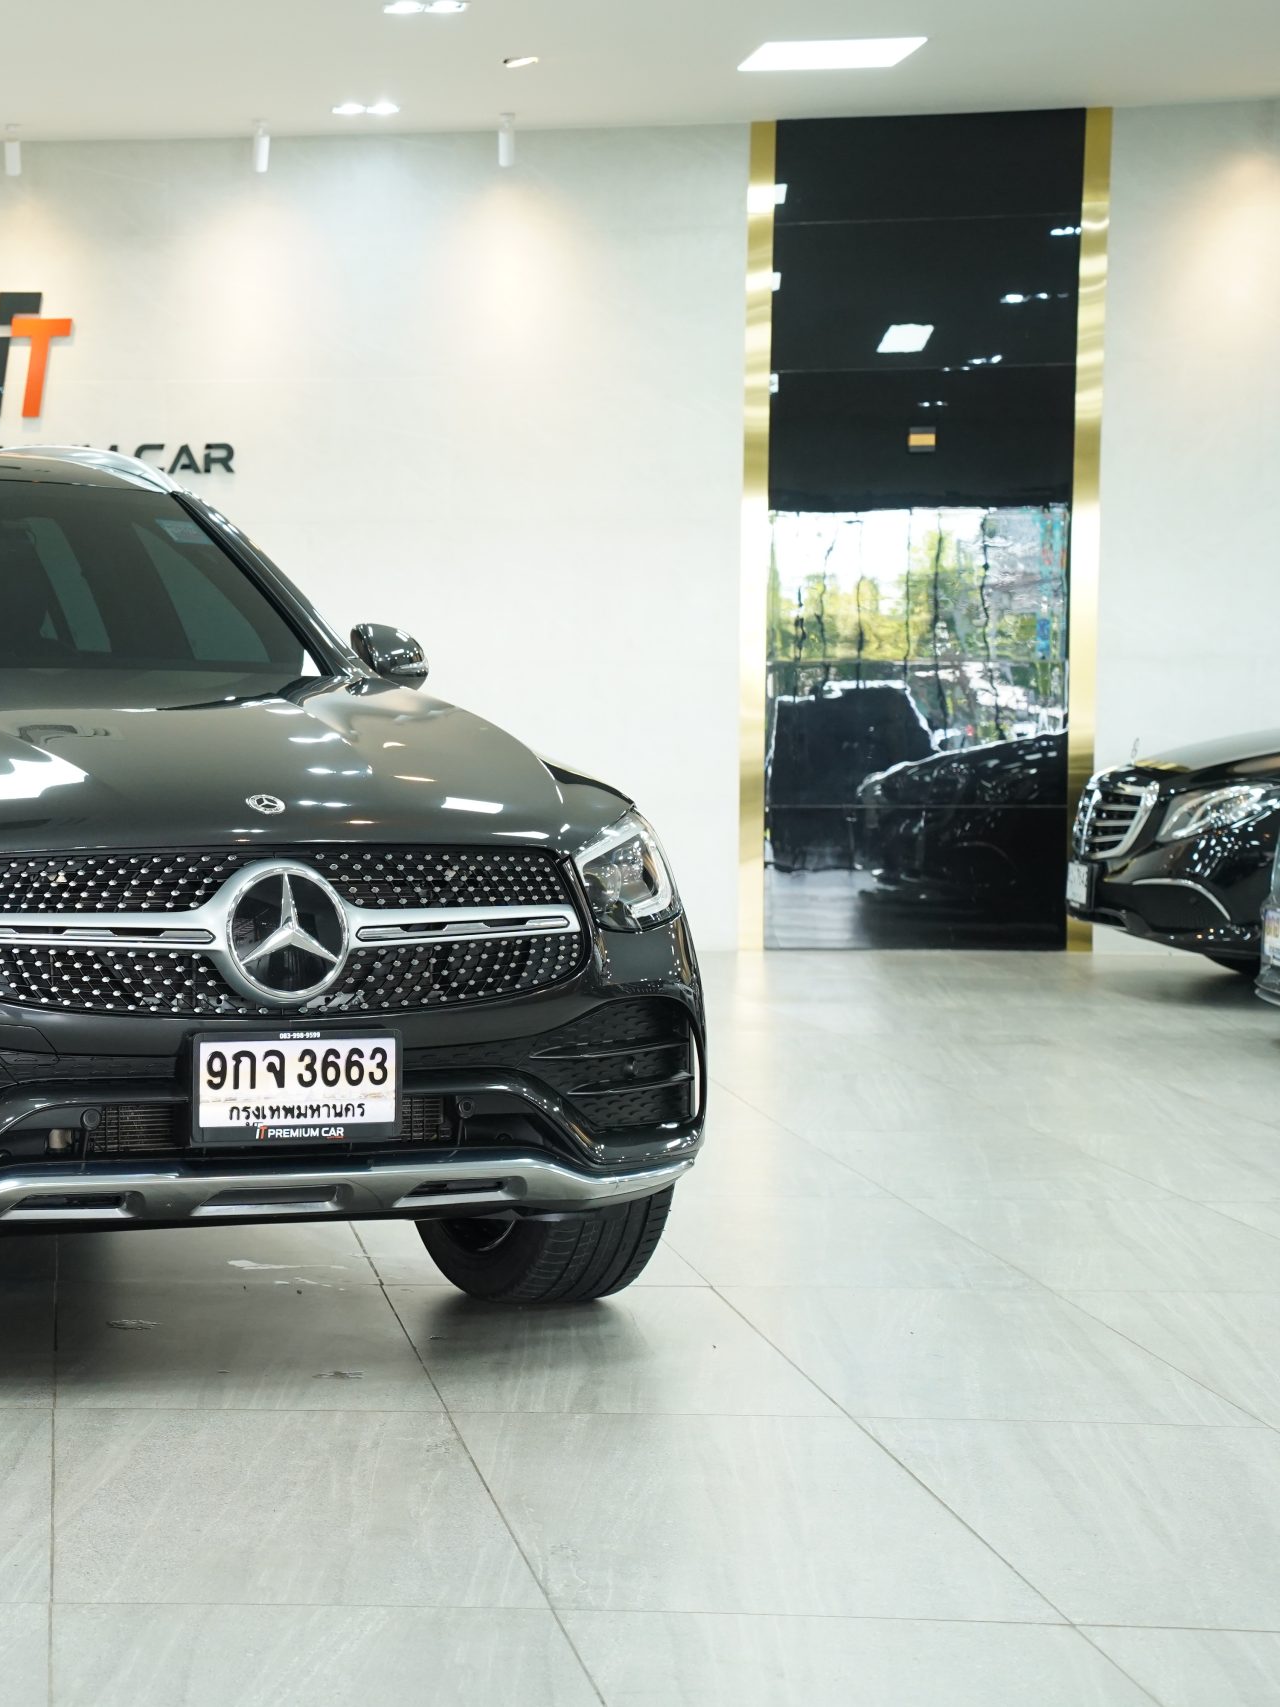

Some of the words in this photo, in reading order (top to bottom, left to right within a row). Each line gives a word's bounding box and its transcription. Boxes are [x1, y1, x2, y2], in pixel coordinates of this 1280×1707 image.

[206, 1049, 286, 1090] 9กจ
[296, 1047, 388, 1087] 3663
[268, 1127, 320, 1139] PREMIUM
[321, 1127, 345, 1137] CAR
